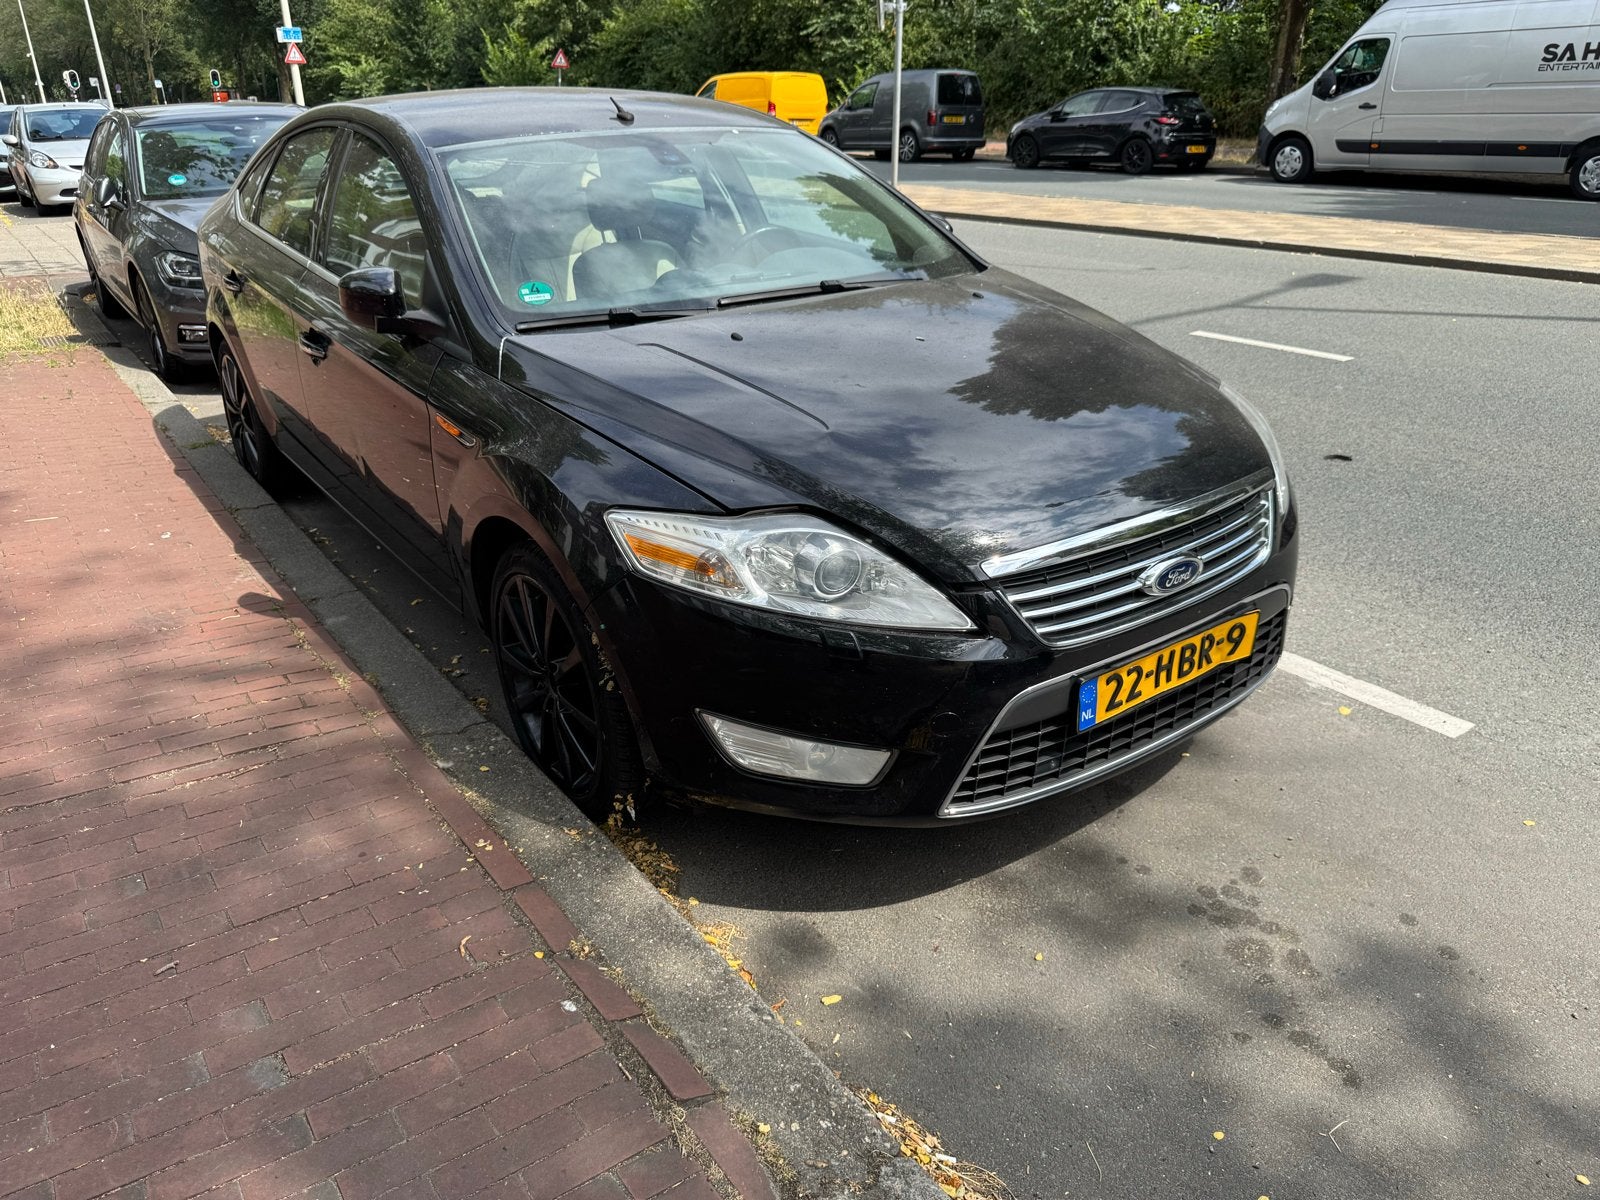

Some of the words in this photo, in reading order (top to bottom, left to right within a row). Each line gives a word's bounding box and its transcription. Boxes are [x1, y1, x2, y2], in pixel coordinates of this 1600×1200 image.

[1541, 43, 1576, 62] SA
[531, 283, 540, 293] 4
[1166, 566, 1192, 587] Ford
[1105, 622, 1246, 713] 22-HBR-9
[1081, 708, 1095, 722] NL
